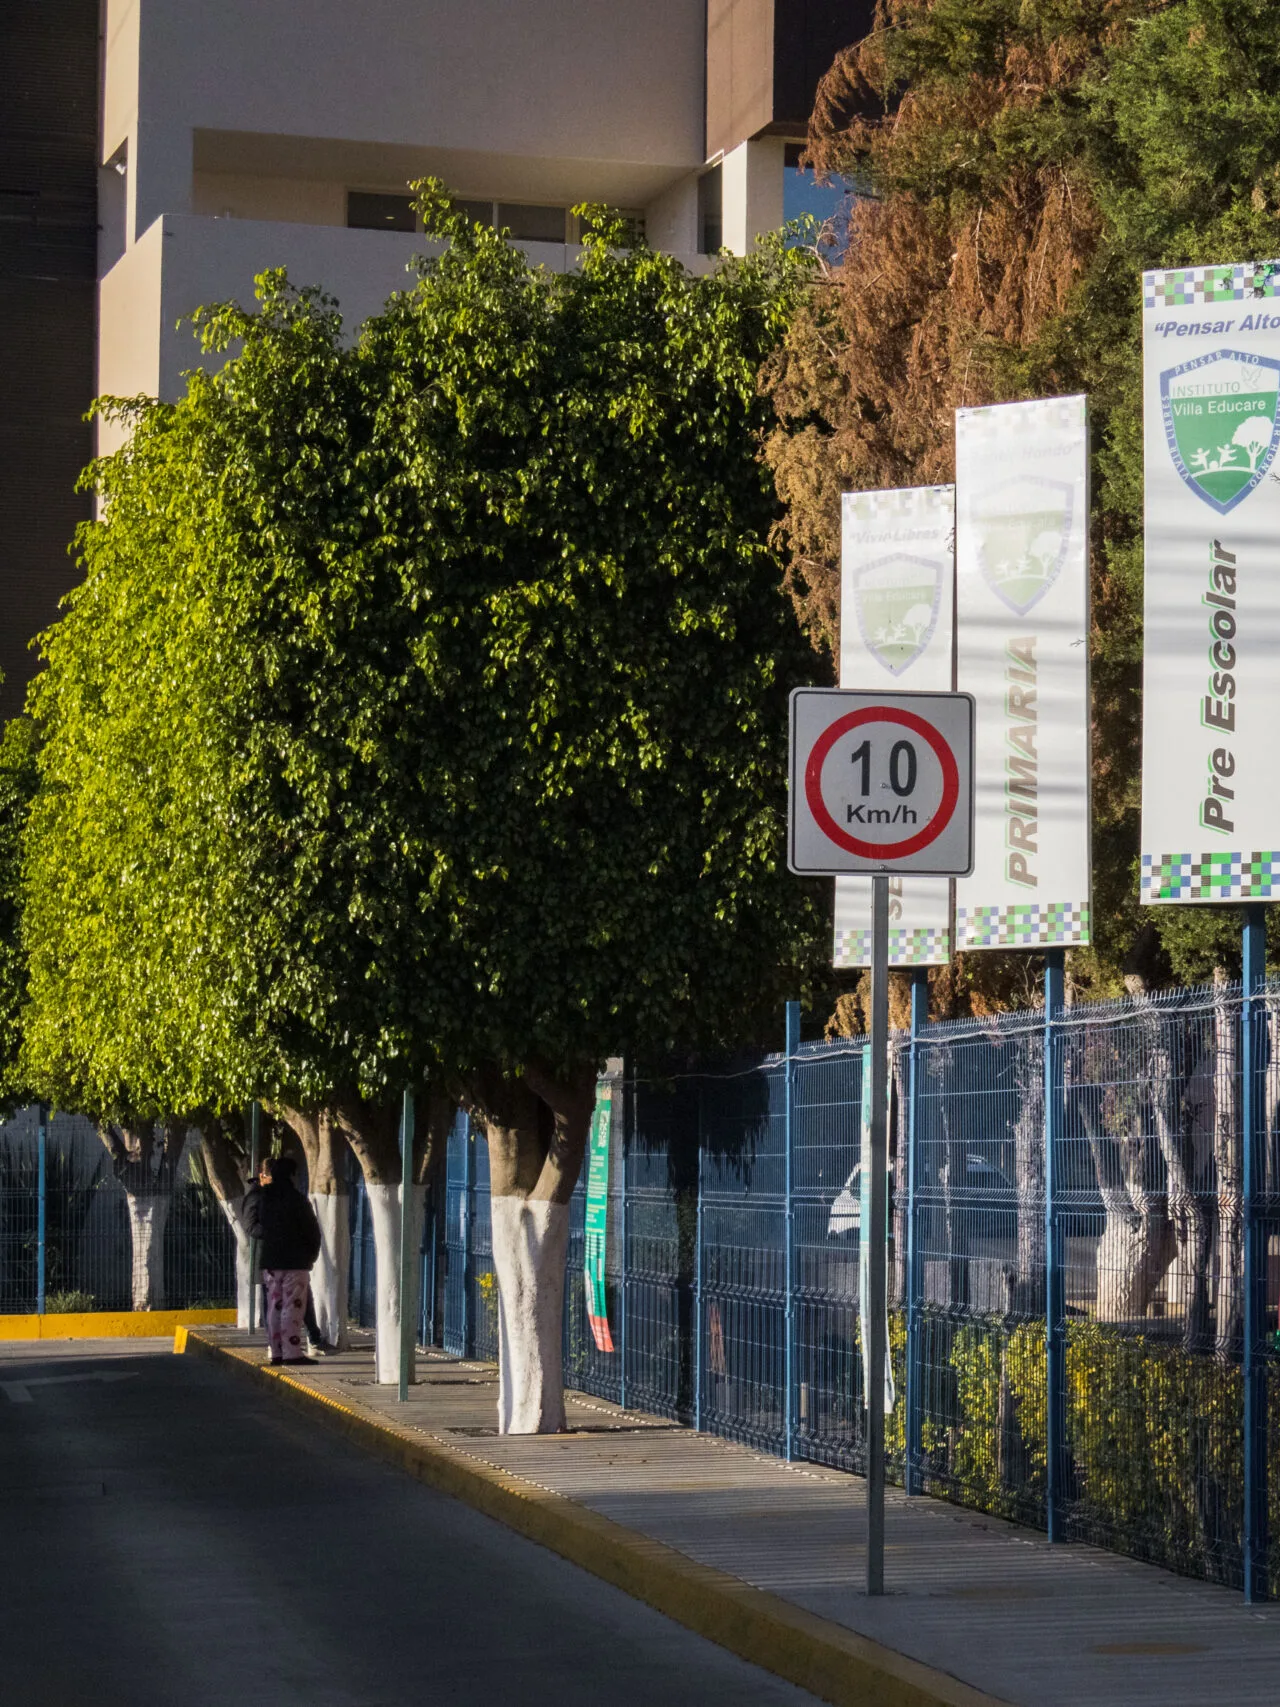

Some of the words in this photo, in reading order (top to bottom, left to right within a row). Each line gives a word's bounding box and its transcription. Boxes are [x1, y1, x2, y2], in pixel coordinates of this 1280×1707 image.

[1174, 350, 1223, 376] PENSAR
[1229, 351, 1260, 366] ALTO
[1172, 380, 1241, 398] INSTITUTO
[1173, 401, 1203, 417] Villa
[1207, 399, 1267, 415] Educare
[1250, 443, 1280, 489] HONDO
[1200, 538, 1237, 734] Escolar
[850, 739, 918, 797] 10
[1004, 635, 1038, 889] PRIMARIA
[846, 803, 918, 825] Km/h
[1199, 747, 1236, 836] Pre
